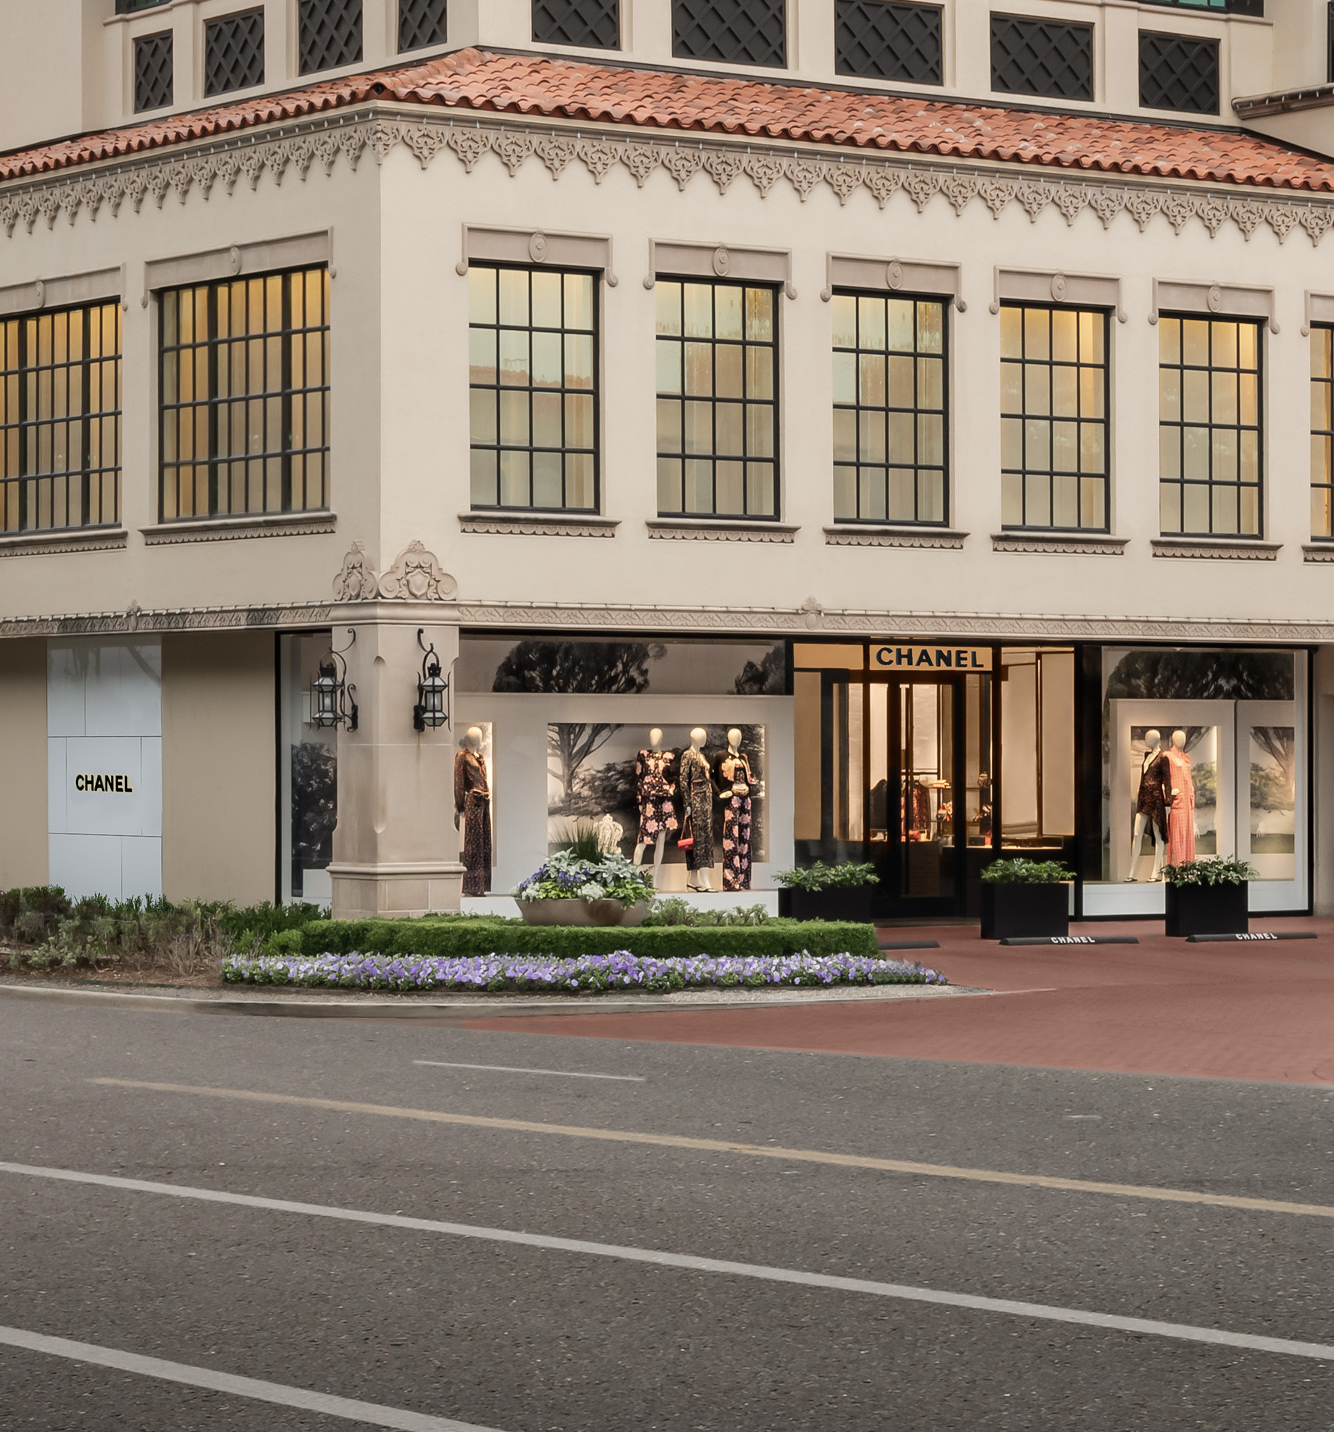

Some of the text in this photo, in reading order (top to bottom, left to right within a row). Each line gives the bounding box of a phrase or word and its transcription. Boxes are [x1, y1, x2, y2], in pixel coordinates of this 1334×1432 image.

[876, 647, 984, 668] CHANEL
[75, 774, 133, 793] CHANEL
[1050, 936, 1096, 944] CHANEL
[1235, 932, 1278, 940] CHANEL
